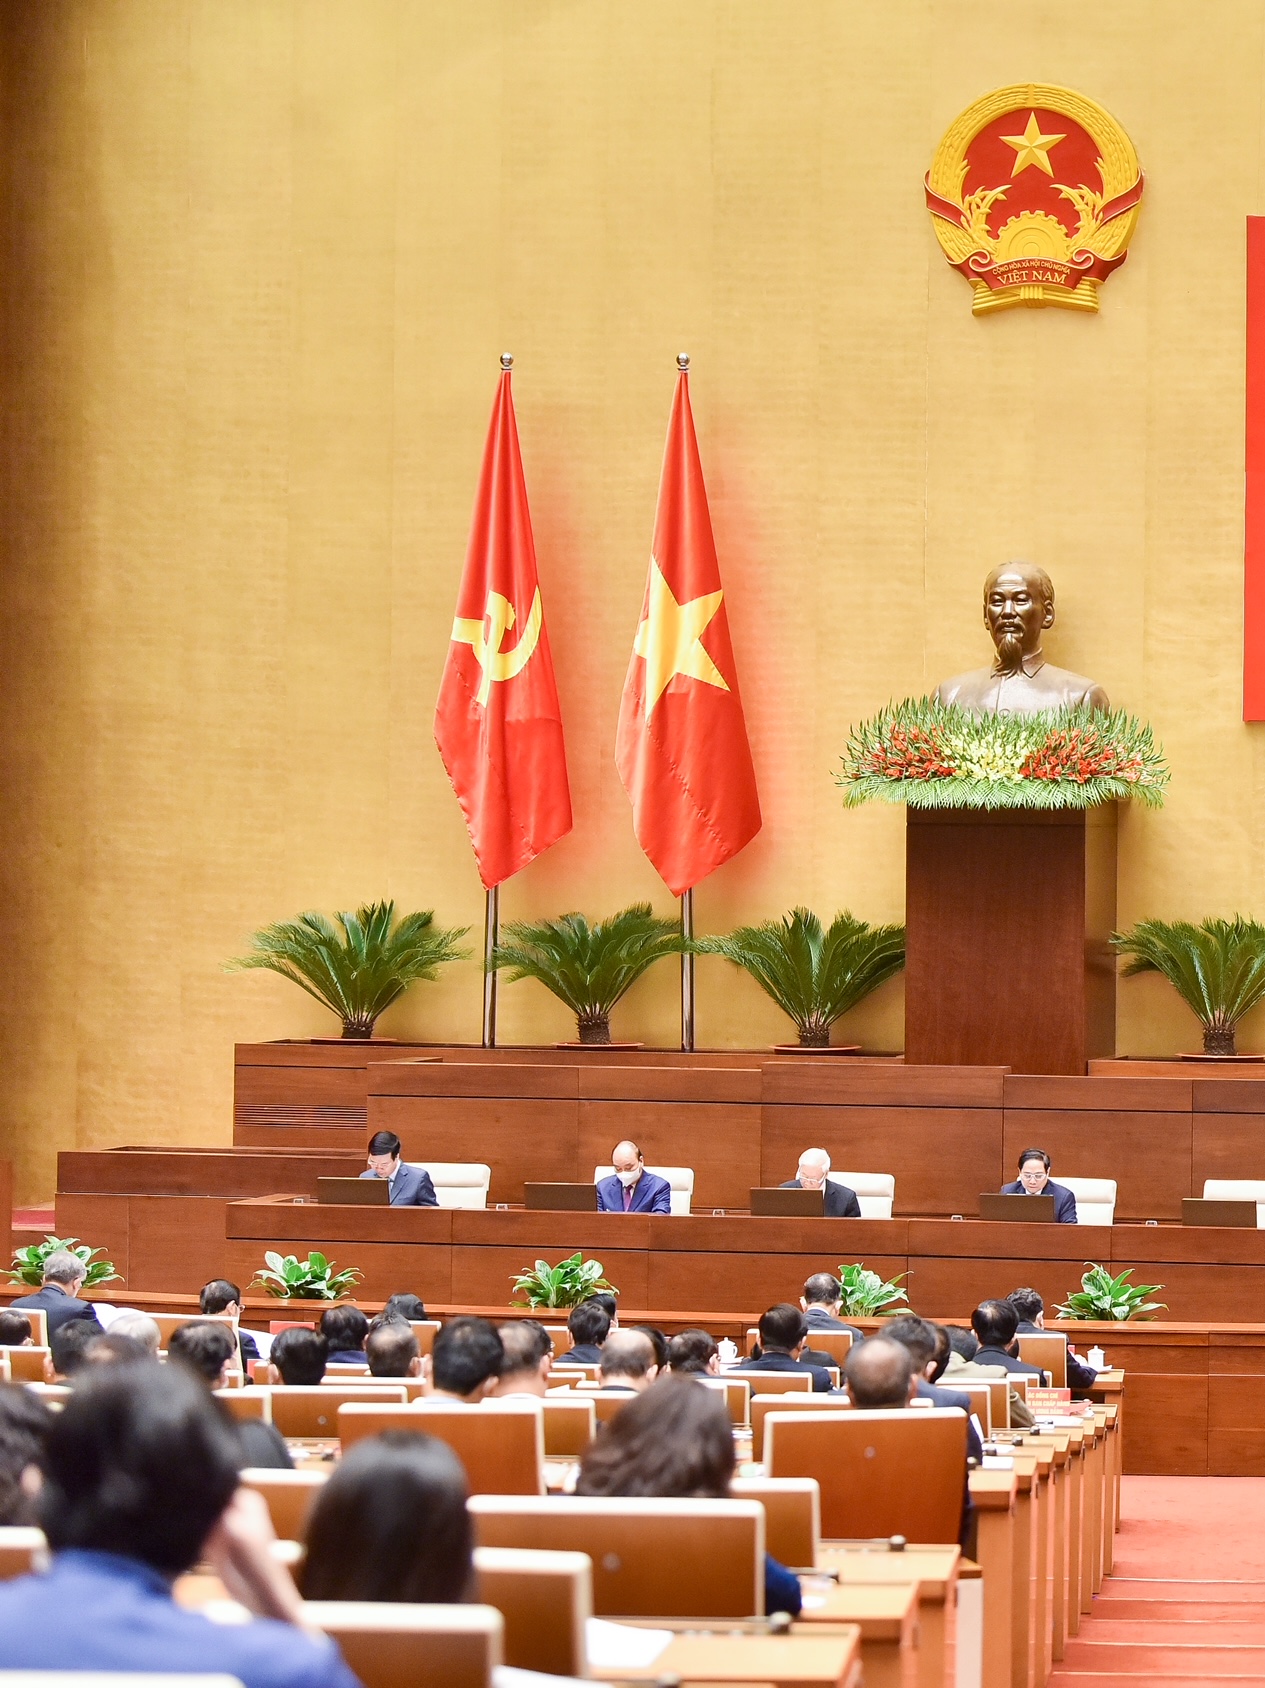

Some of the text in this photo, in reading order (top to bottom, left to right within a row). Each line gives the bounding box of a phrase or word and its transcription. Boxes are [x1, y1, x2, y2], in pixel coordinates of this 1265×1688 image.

[993, 265, 1009, 275] CỘNG
[1009, 262, 1022, 270] HÒA
[1022, 260, 1030, 268] XÃ
[1030, 259, 1040, 268] HỘI
[1053, 263, 1070, 275] NGHĨA
[997, 270, 1067, 284] VIỆT NAM
